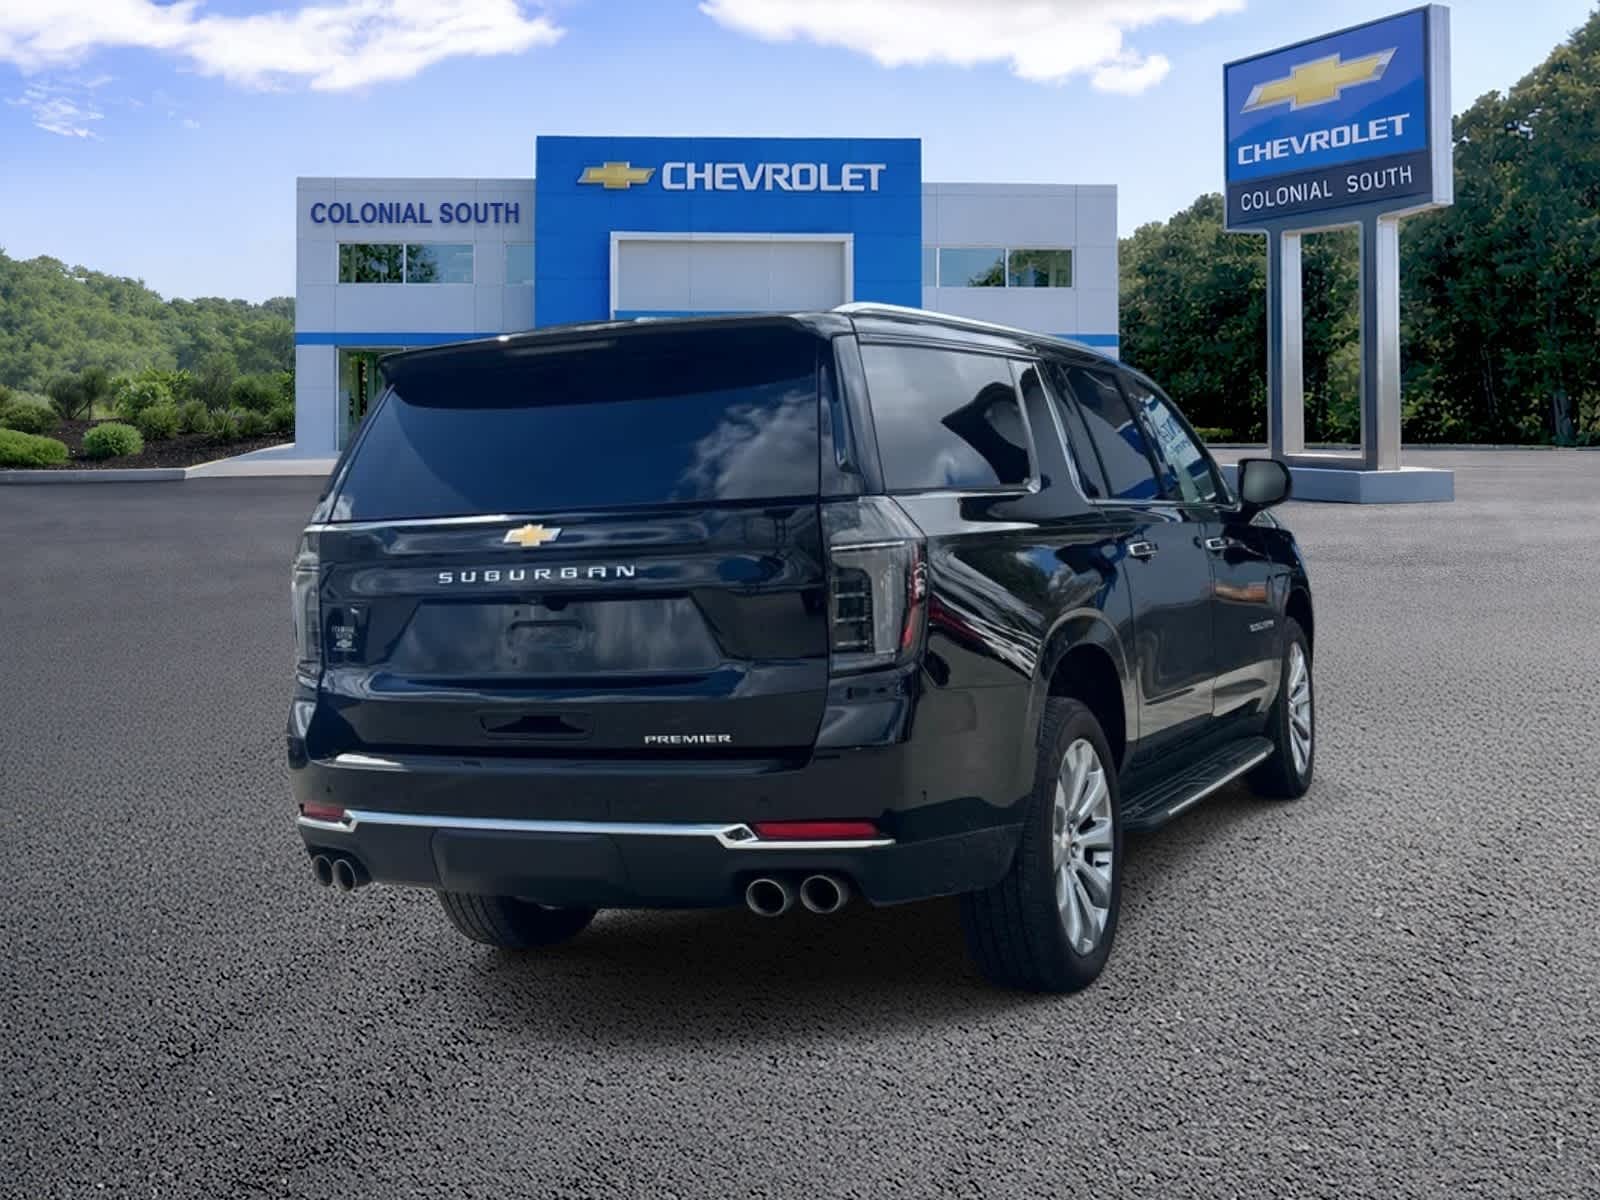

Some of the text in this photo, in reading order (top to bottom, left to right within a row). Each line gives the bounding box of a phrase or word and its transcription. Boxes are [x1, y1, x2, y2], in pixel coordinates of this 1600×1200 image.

[1237, 113, 1410, 165] CHEVROLET
[661, 162, 887, 193] CHEVROLET
[1240, 165, 1413, 211] COLONIAL SOUTH
[311, 202, 520, 224] COLONIAL SOUTH
[438, 564, 636, 585] SUBURBAN
[643, 733, 733, 745] PREMIER
